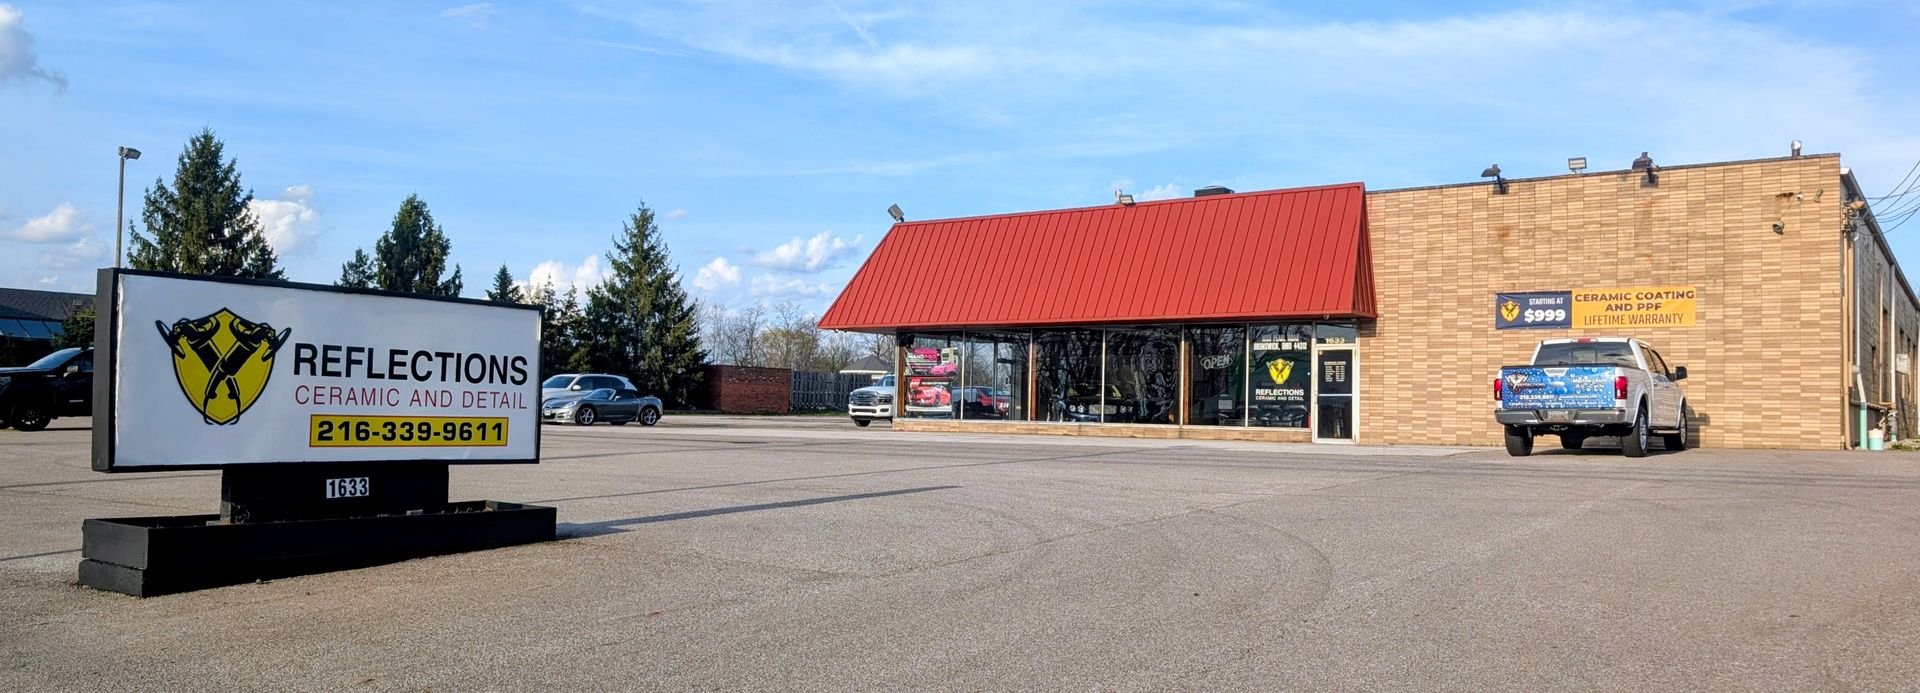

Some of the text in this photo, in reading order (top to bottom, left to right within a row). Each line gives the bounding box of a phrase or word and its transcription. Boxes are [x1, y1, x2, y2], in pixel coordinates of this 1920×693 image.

[1528, 297, 1564, 306] STARTING AT
[1574, 290, 1695, 302] CERAMIC COATING
[1605, 302, 1662, 312] AND PPF
[1524, 308, 1566, 323] $999
[1584, 313, 1684, 326] LIFETIME WARRANTY
[294, 343, 528, 385] REFLECTIONS
[1203, 354, 1230, 370] OPEN
[295, 385, 527, 409] CERAMIC AND DETAIL
[1255, 388, 1305, 396] REFLECTIONS
[318, 420, 502, 441] 216-339-9611
[328, 477, 368, 497] 1633
